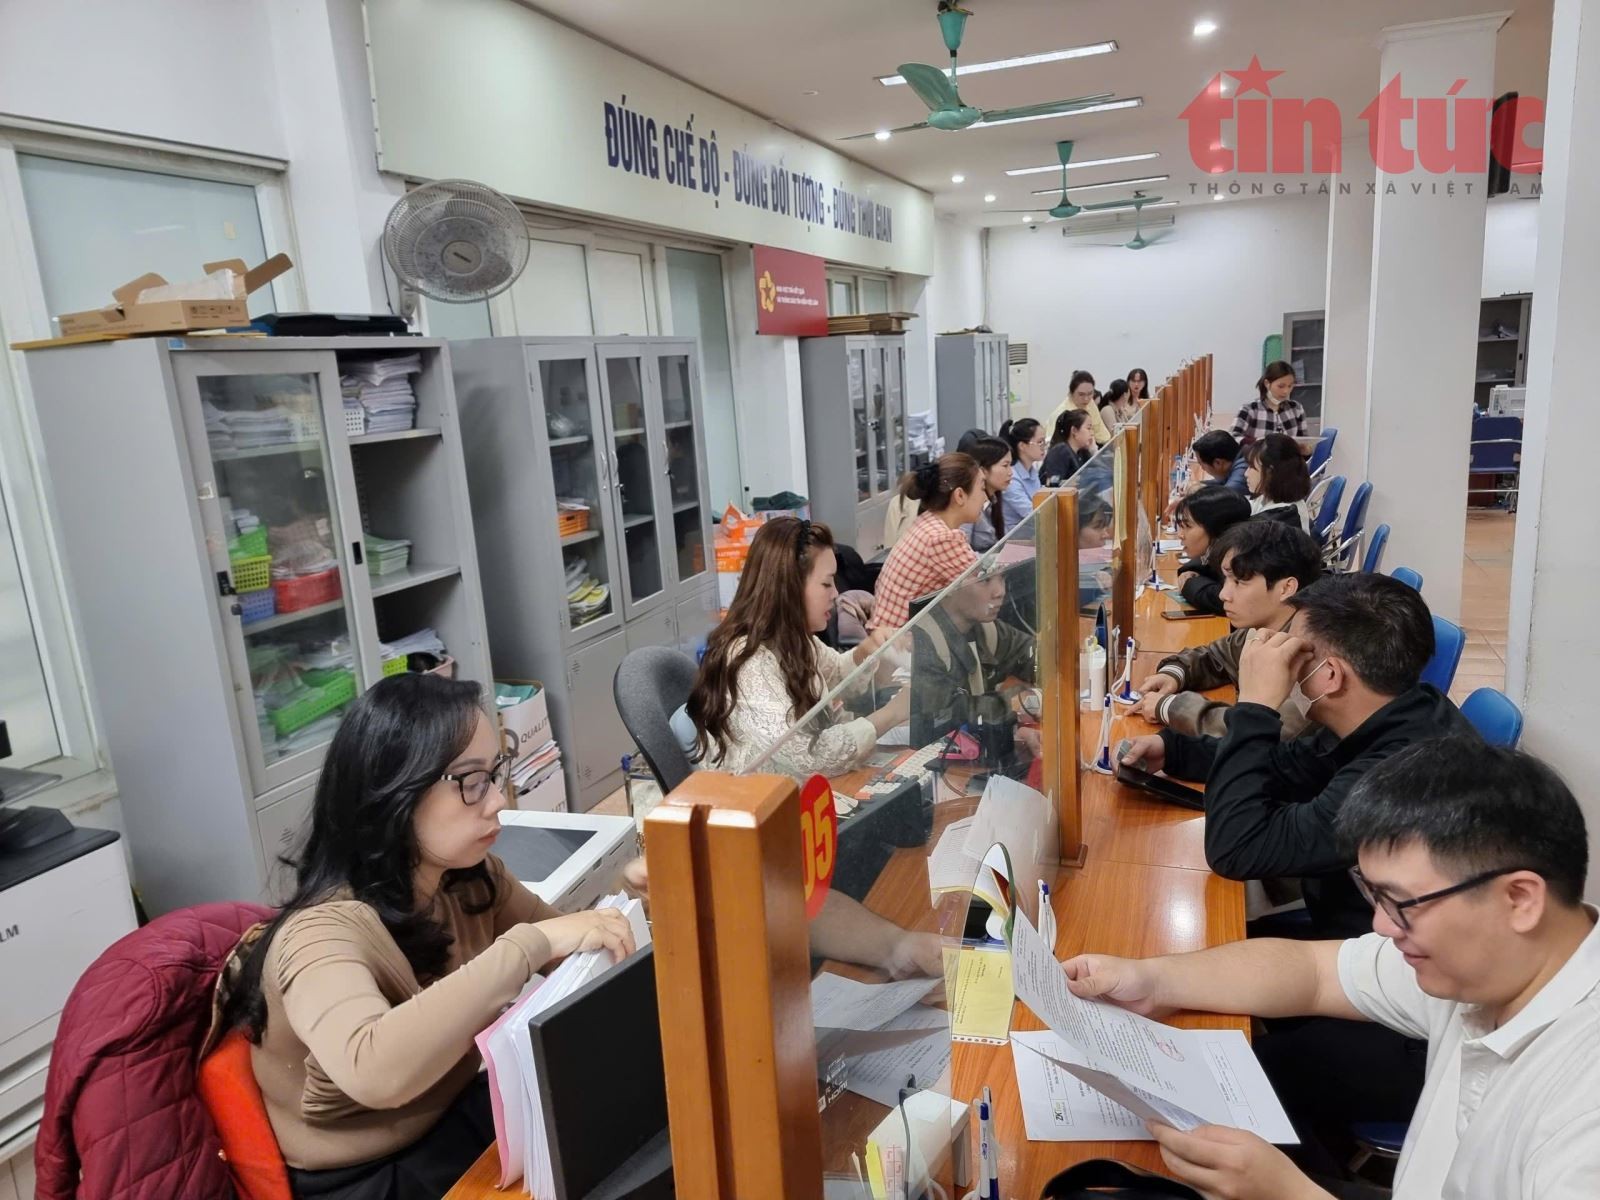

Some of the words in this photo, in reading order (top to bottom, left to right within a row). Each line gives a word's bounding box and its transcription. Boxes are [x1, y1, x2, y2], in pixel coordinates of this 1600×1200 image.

[603, 94, 660, 180] ĐÚNG
[663, 113, 697, 190] CHẾ
[699, 130, 720, 209] ĐỘ
[732, 144, 769, 210] ĐÚNG
[771, 153, 791, 216] ĐỐI
[792, 172, 825, 233] TƯỢNG
